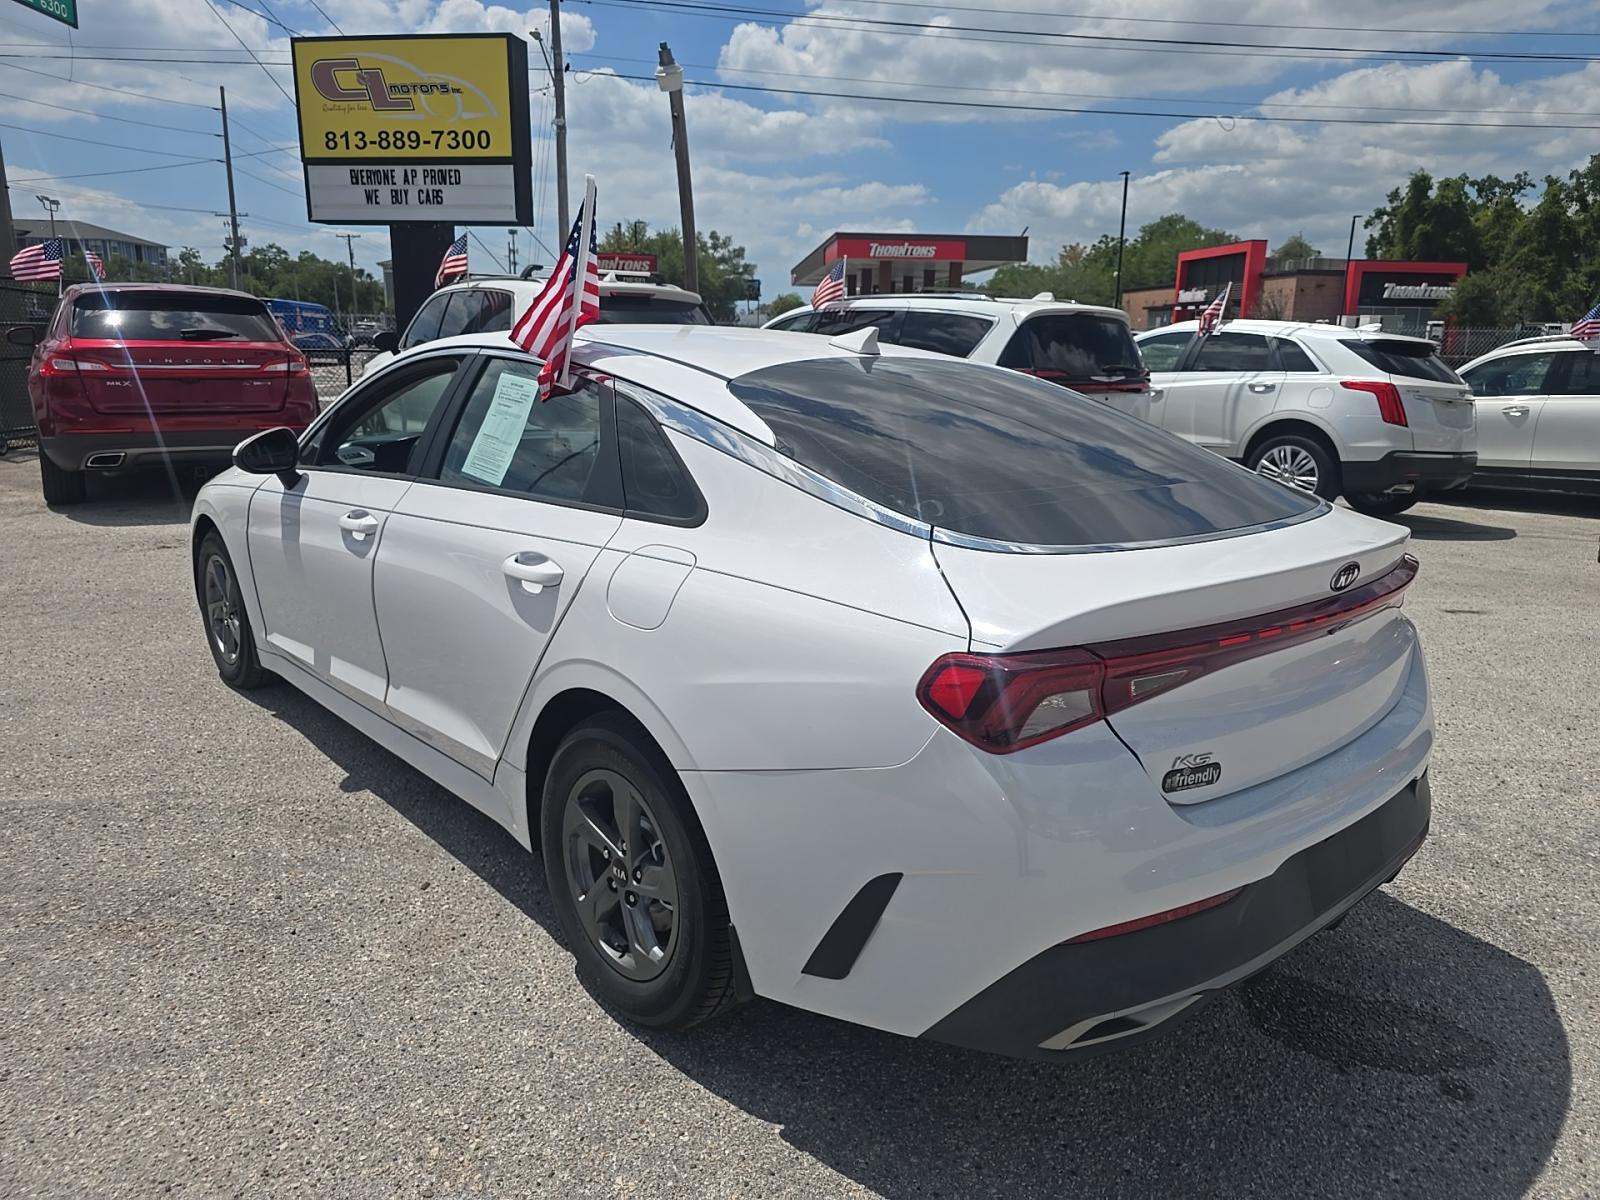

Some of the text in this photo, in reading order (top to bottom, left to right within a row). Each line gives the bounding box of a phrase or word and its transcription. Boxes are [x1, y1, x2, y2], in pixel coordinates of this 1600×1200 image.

[324, 129, 491, 150] 813-889-7300
[403, 169, 417, 185] AP
[364, 189, 444, 205] WE BUY CARS
[597, 256, 650, 271] RNTONS
[613, 865, 627, 881] KIA
